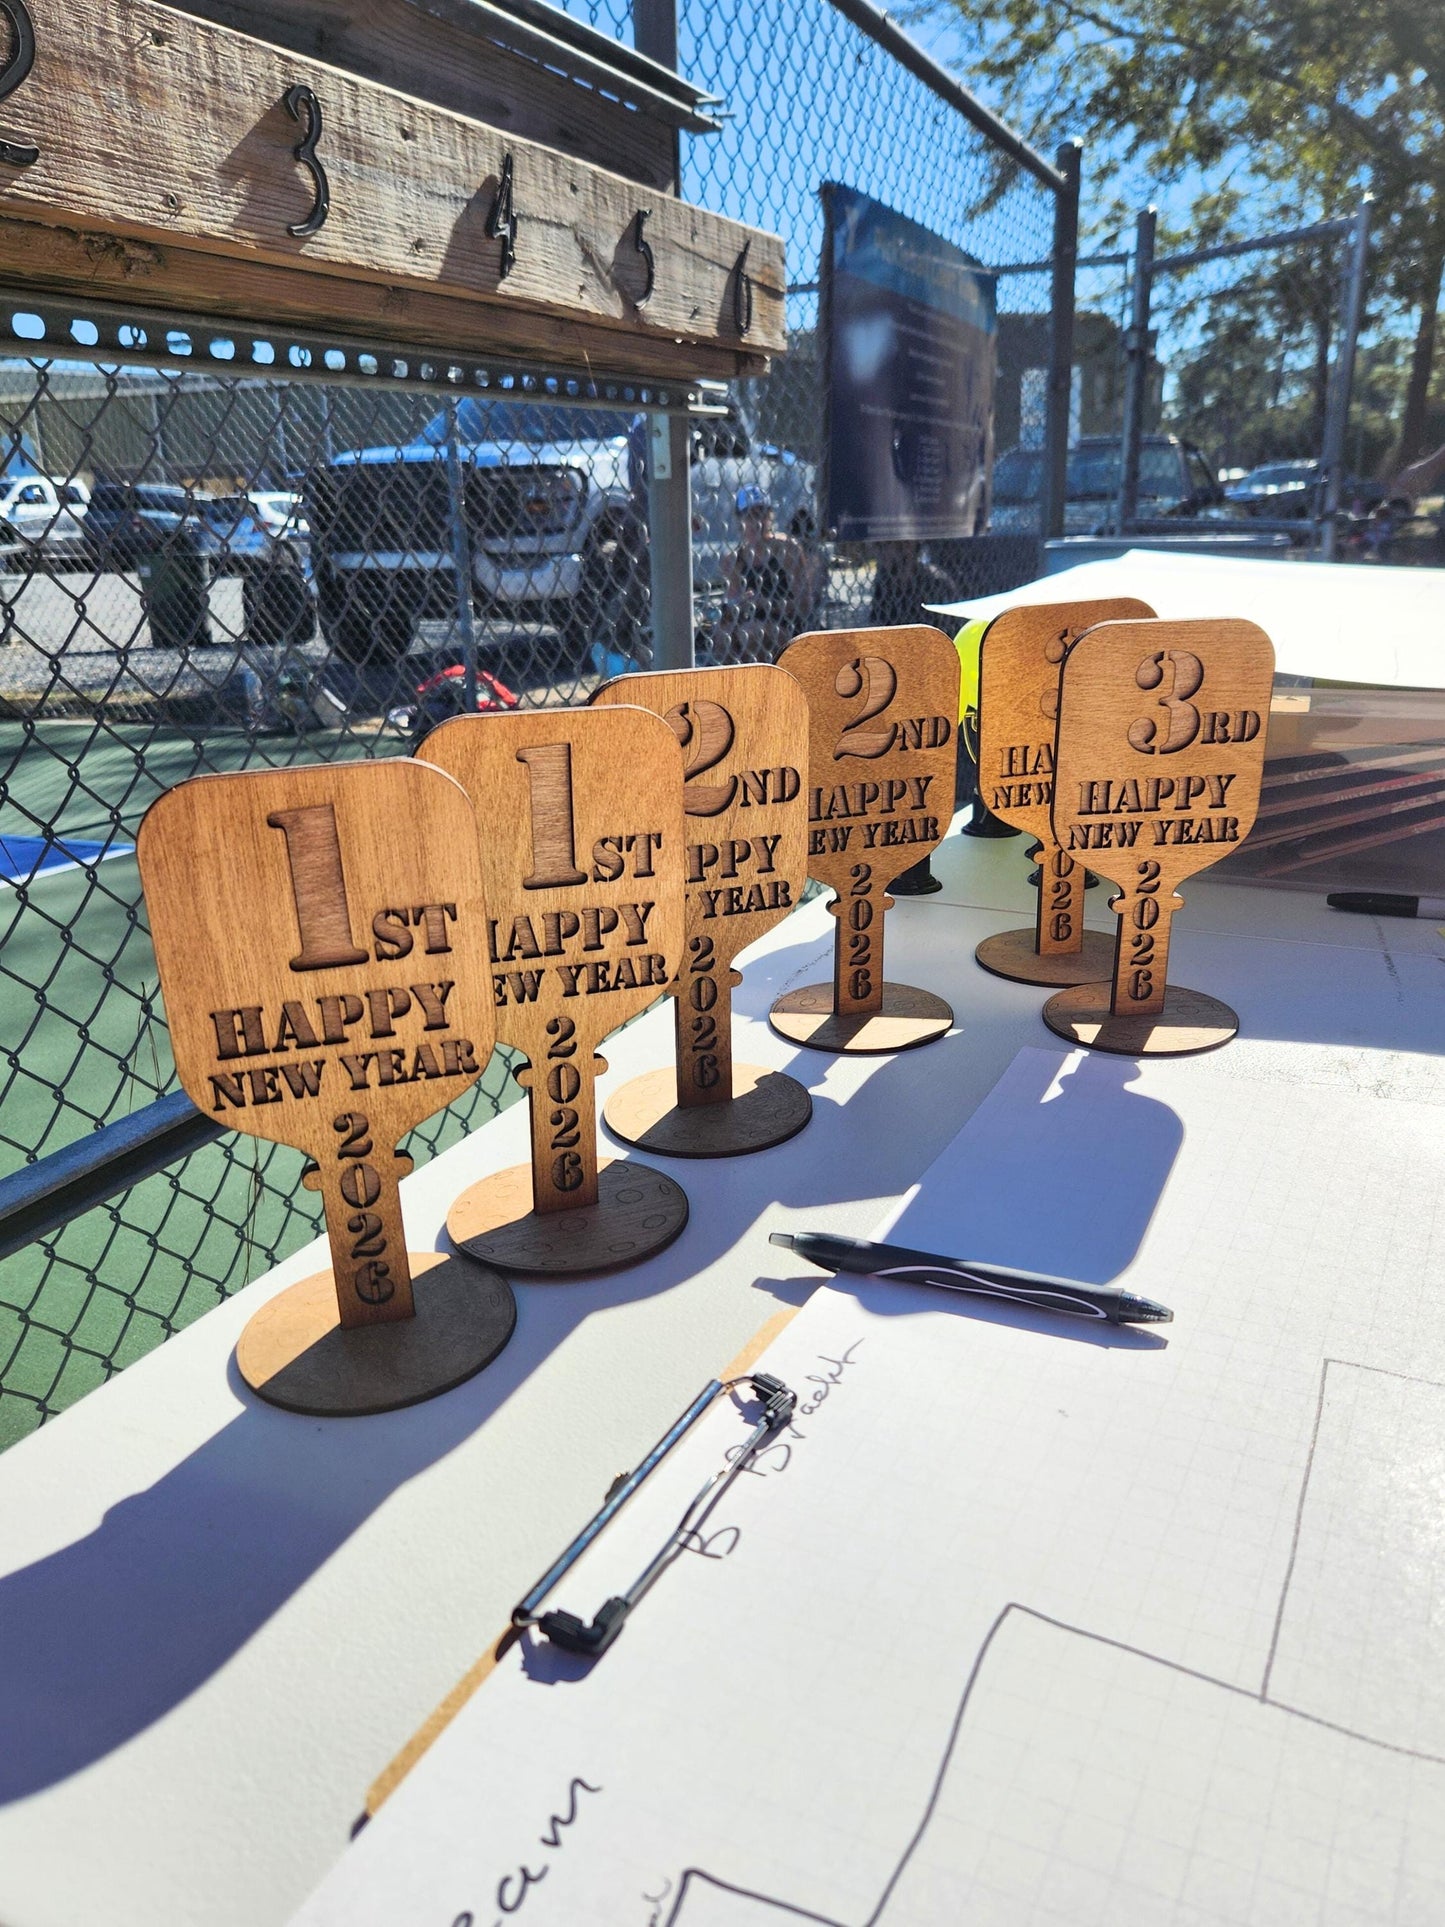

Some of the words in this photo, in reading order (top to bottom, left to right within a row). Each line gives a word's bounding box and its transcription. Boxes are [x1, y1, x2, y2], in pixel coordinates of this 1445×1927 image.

[285, 84, 330, 237] 3
[484, 153, 518, 280] 4
[633, 208, 655, 311] 5
[734, 240, 753, 338] 6
[834, 656, 951, 761] 2ND
[1128, 649, 1260, 755] 3RD
[663, 701, 801, 817] 2ND
[1077, 774, 1237, 816] HAPPY
[515, 743, 662, 890] 1ST
[686, 834, 782, 883] PPY
[808, 825, 853, 855] EW
[861, 816, 940, 849] YEAR
[1067, 821, 1146, 850] NEW
[1152, 815, 1240, 847] YEAR
[267, 803, 457, 973] 1ST
[699, 880, 793, 919] YEAR
[847, 862, 874, 1001] 2026
[1049, 845, 1076, 943] 026
[1127, 859, 1161, 1002] 2026
[208, 980, 456, 1061] HAPPY
[491, 969, 546, 1007] EW
[555, 953, 670, 998] YEAR
[689, 935, 721, 1089] 2026
[207, 1059, 327, 1112] NEW
[337, 1037, 480, 1091] YEAR
[545, 1015, 585, 1192] 2026
[332, 1111, 396, 1306] 2026
